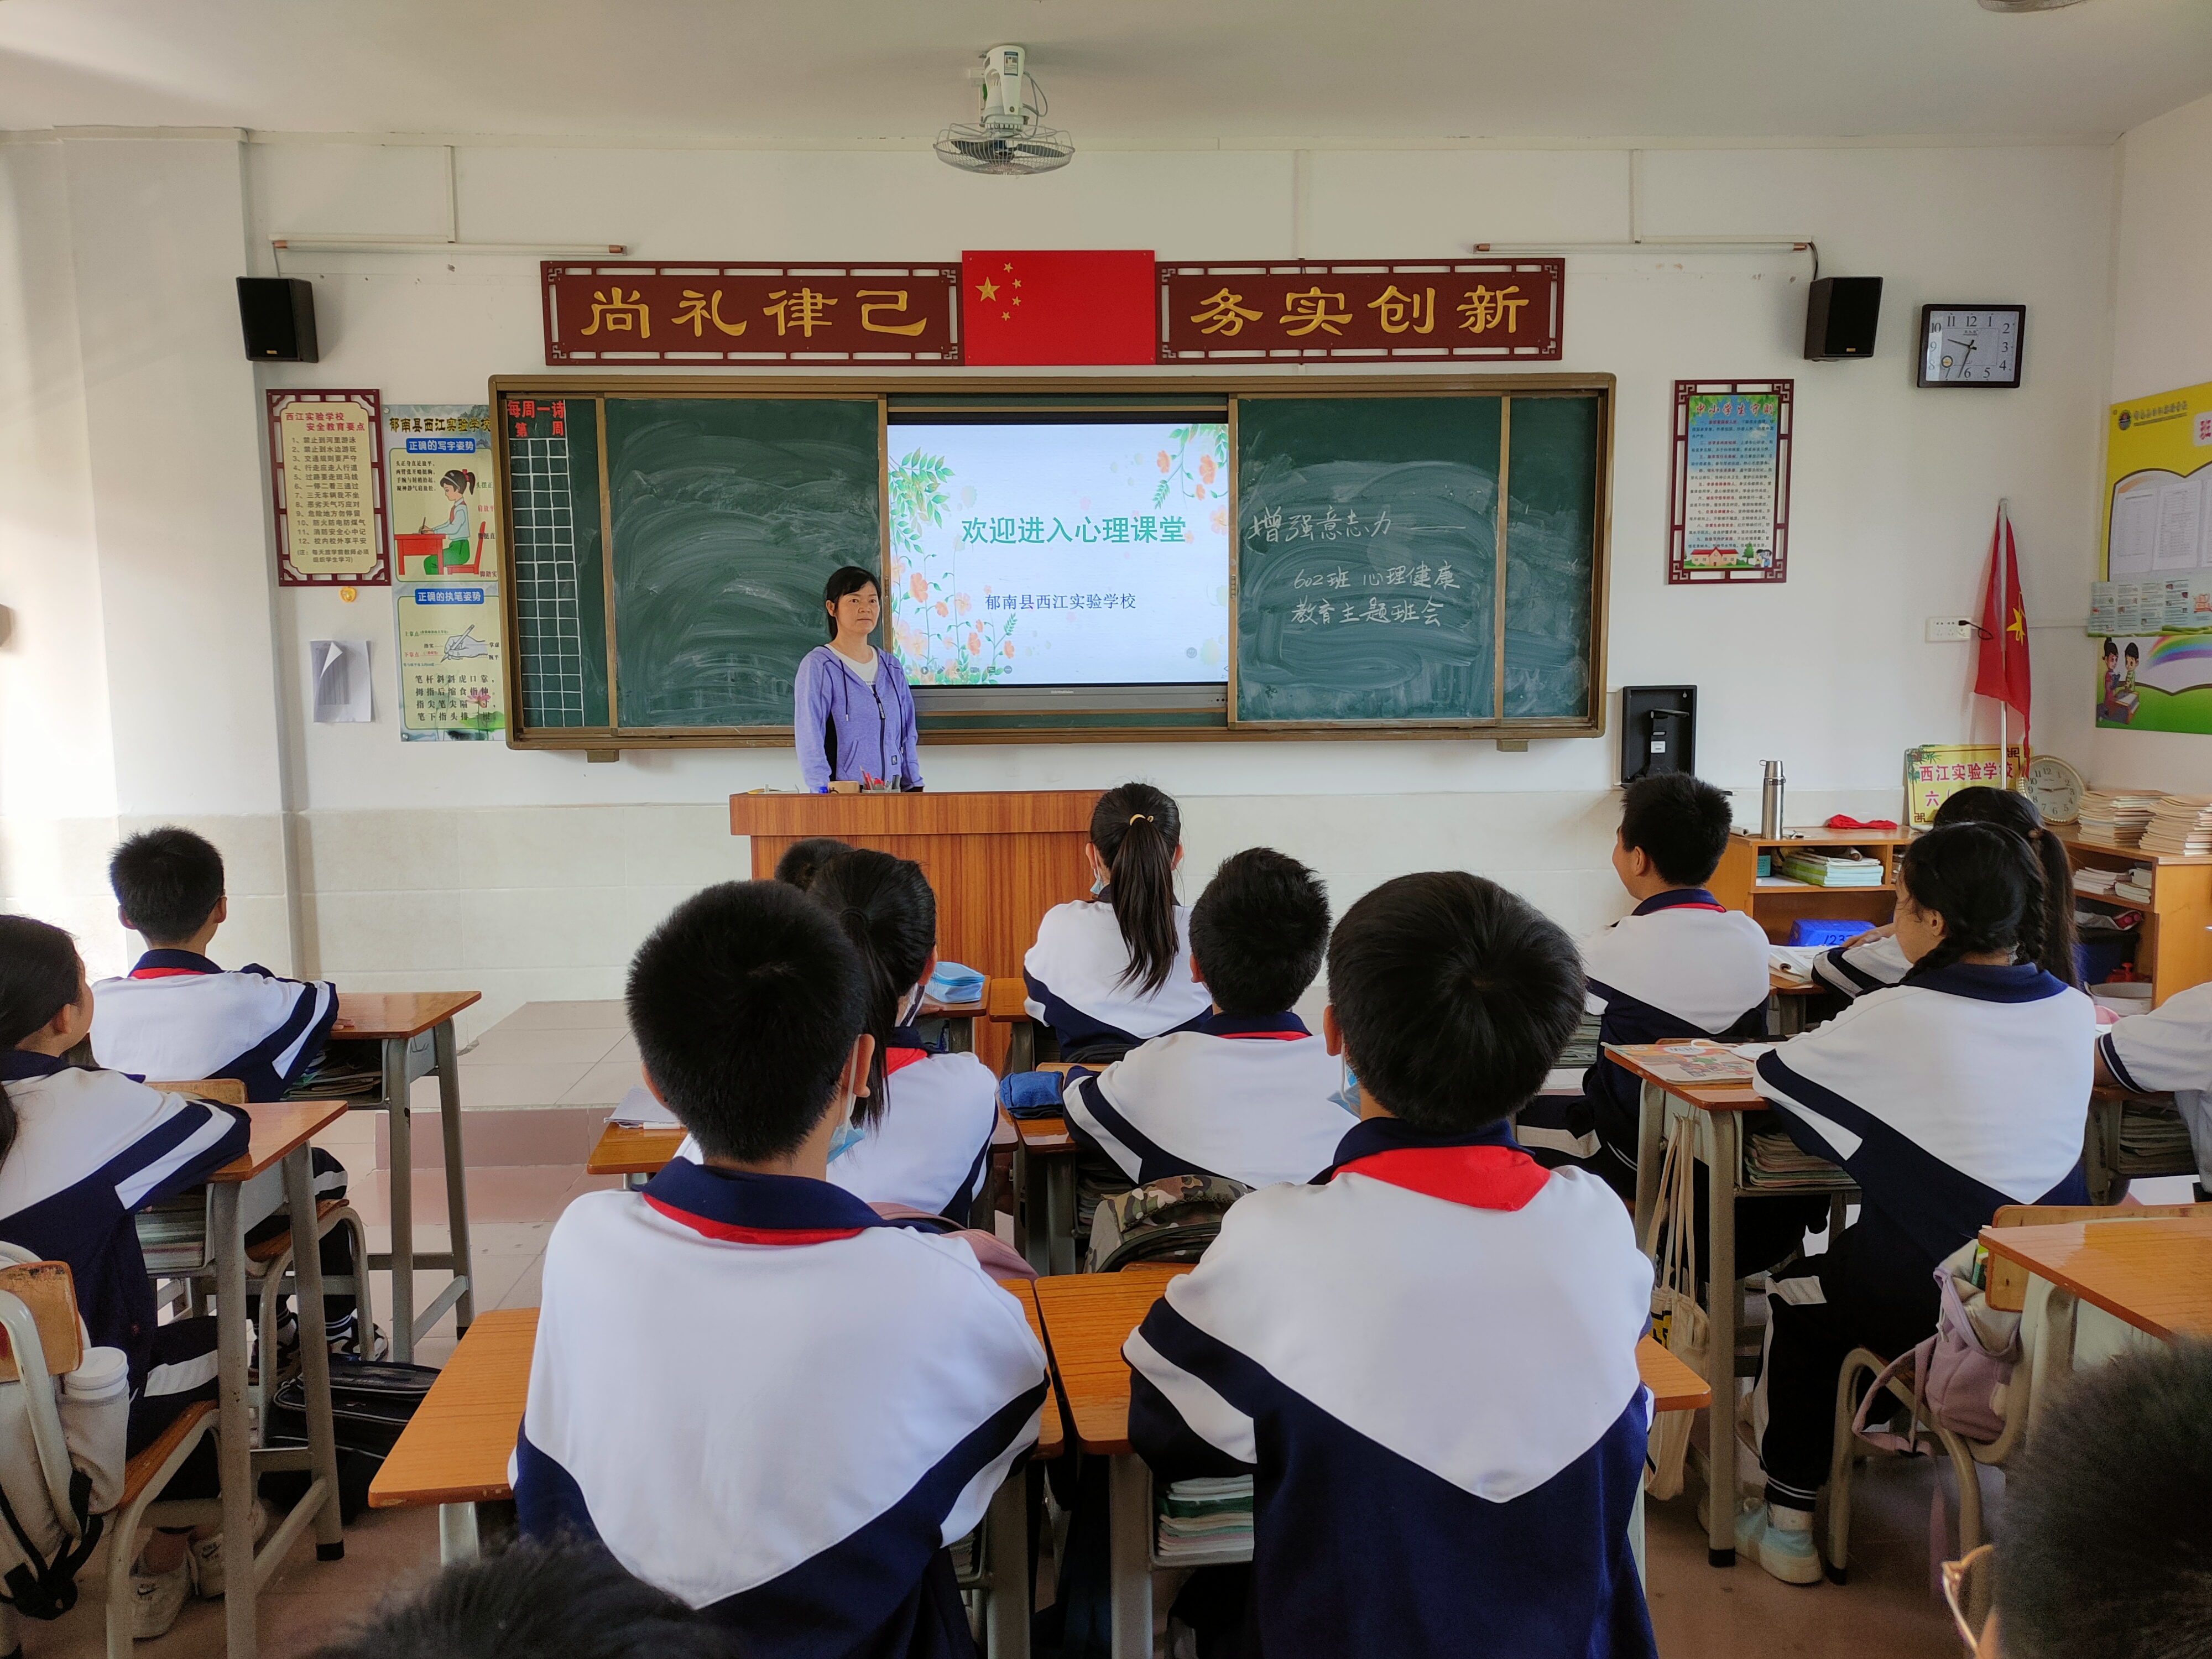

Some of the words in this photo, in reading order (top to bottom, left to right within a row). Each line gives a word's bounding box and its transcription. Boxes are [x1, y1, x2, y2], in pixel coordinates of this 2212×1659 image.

[581, 286, 927, 339] 尚礼律己
[1190, 284, 1530, 336] 务实创新
[1947, 316, 1955, 327] 11
[1966, 316, 1977, 327] 12
[1987, 316, 1992, 327] 1
[1931, 322, 1942, 333] 10
[2002, 323, 2010, 334] 2
[1930, 341, 1937, 352] 9
[2002, 342, 2008, 353] 3
[1928, 359, 1935, 371] 8
[1999, 360, 2006, 371] 4
[1964, 367, 1971, 378] 6
[1983, 367, 1990, 378] 5
[507, 400, 564, 419] 每周一诗
[1696, 402, 1774, 416] 中小学生守则
[285, 412, 345, 421] 西江实验学校
[306, 422, 365, 431] 安全教育要点
[389, 418, 491, 432] 郁南县西江实验学校
[515, 422, 528, 437] 第
[552, 421, 564, 436] 周
[409, 440, 474, 451] 正确的写字姿势
[961, 515, 1186, 545] 欢迎进入心理课堂
[1294, 566, 1350, 589] 602班
[1363, 560, 1461, 589] 心理健康
[418, 591, 481, 602] 正确的执笔姿势
[985, 593, 1136, 611] 郁南县西江实验学校
[1291, 594, 1444, 627] 教育主题班会
